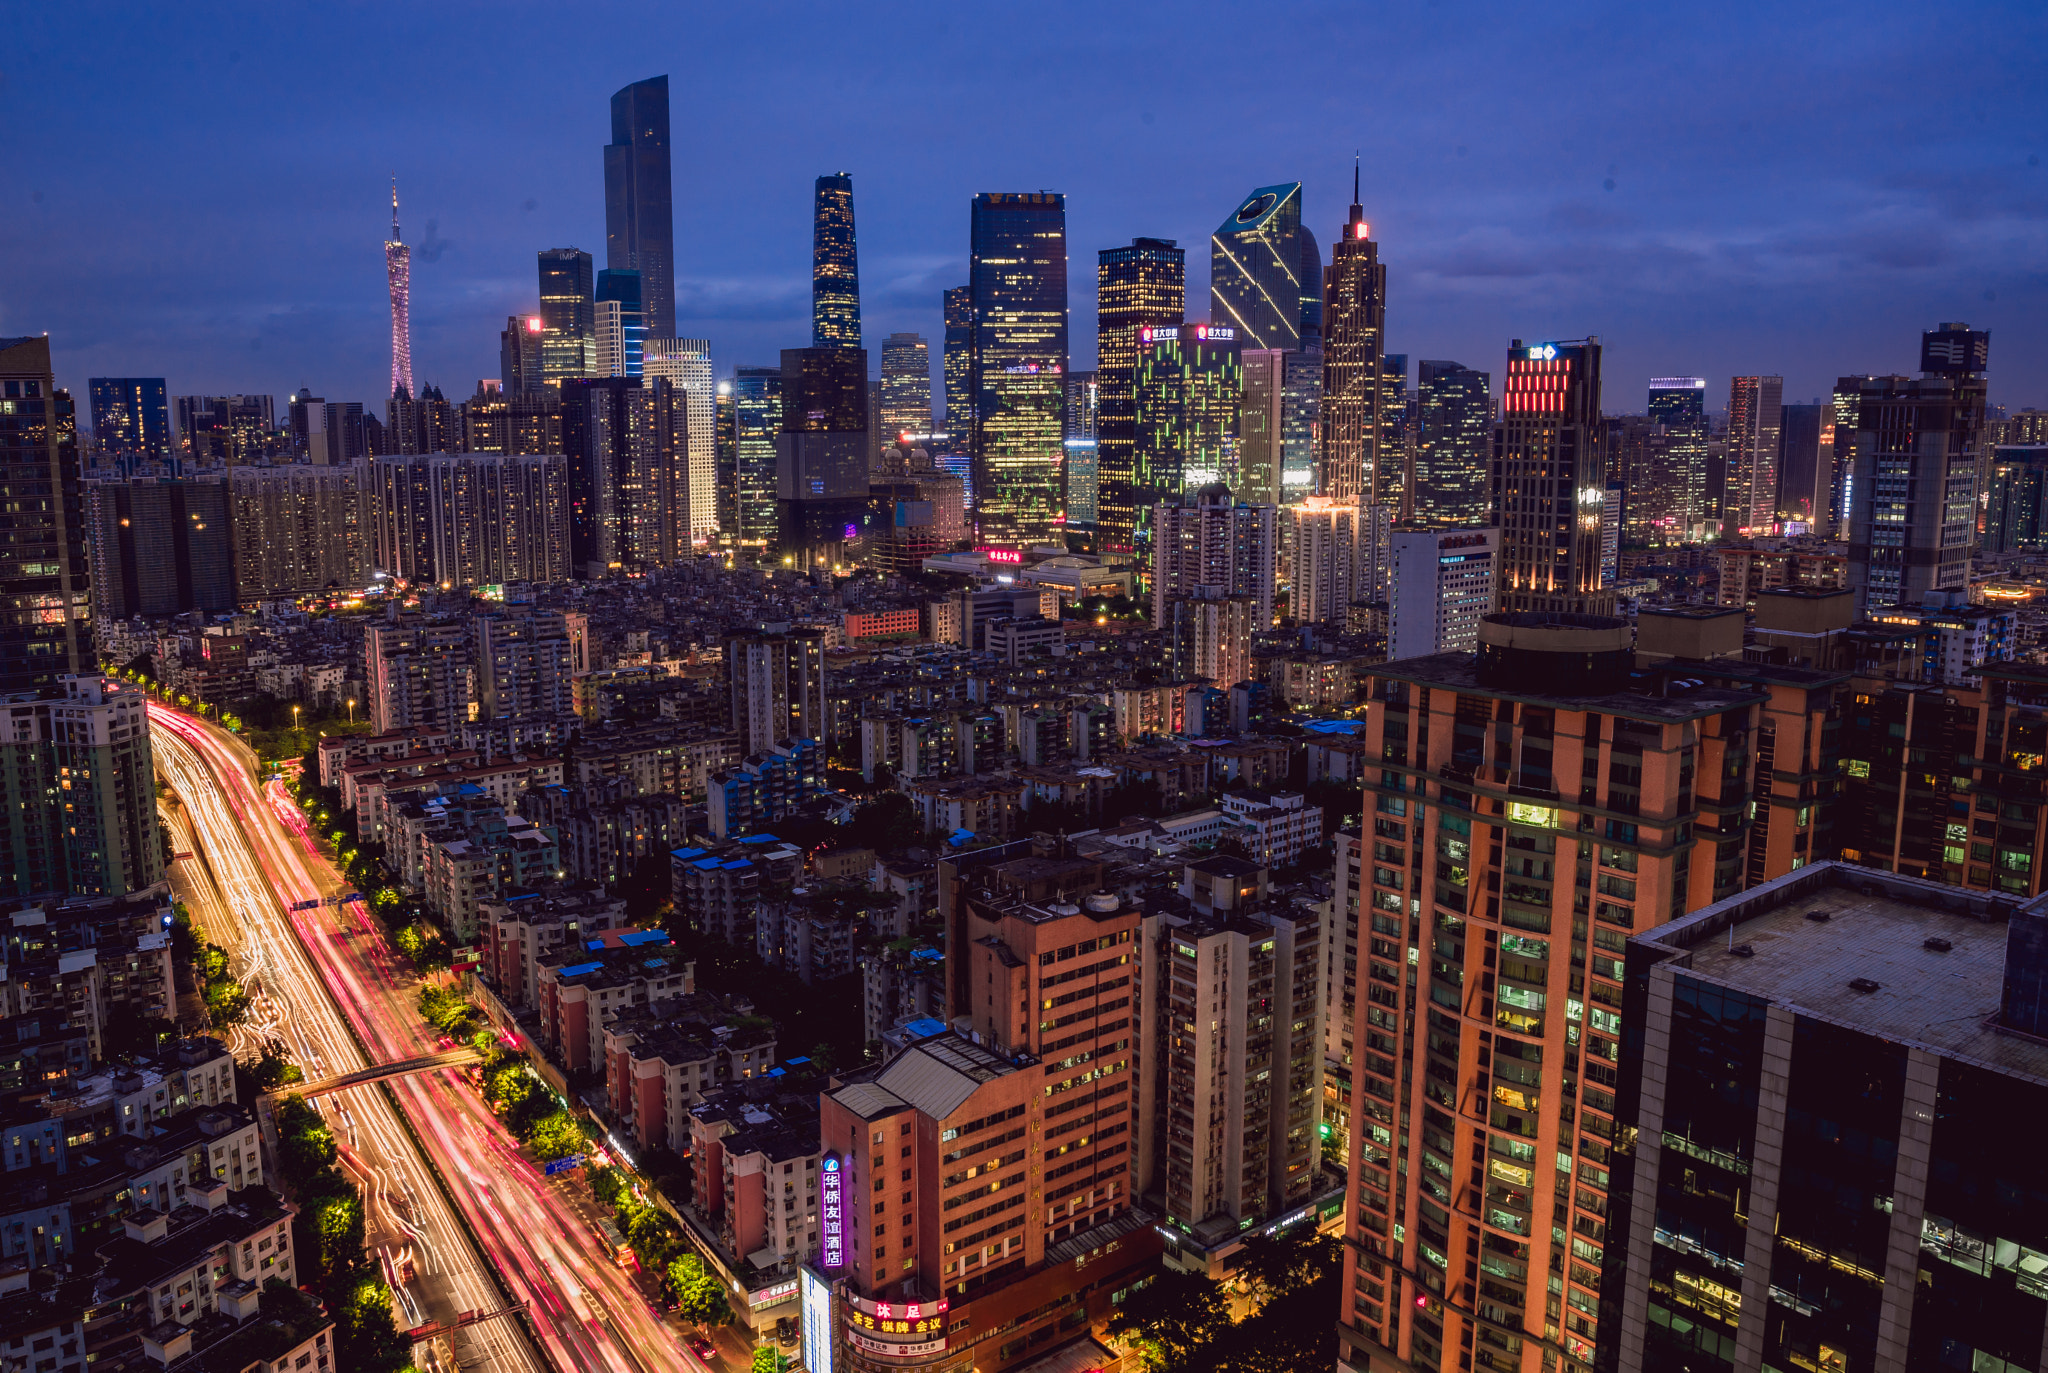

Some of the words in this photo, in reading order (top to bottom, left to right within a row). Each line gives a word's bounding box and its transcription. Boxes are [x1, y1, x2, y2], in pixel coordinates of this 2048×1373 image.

[825, 1174, 840, 1264] 华侨友谊酒店
[876, 1302, 921, 1318] 沐足
[853, 1311, 875, 1330] 茶艺
[881, 1320, 909, 1334] 棋牌
[915, 1317, 942, 1332] 会议
[863, 1338, 888, 1350] 华泰证券
[910, 1342, 936, 1351] 华泰证券
